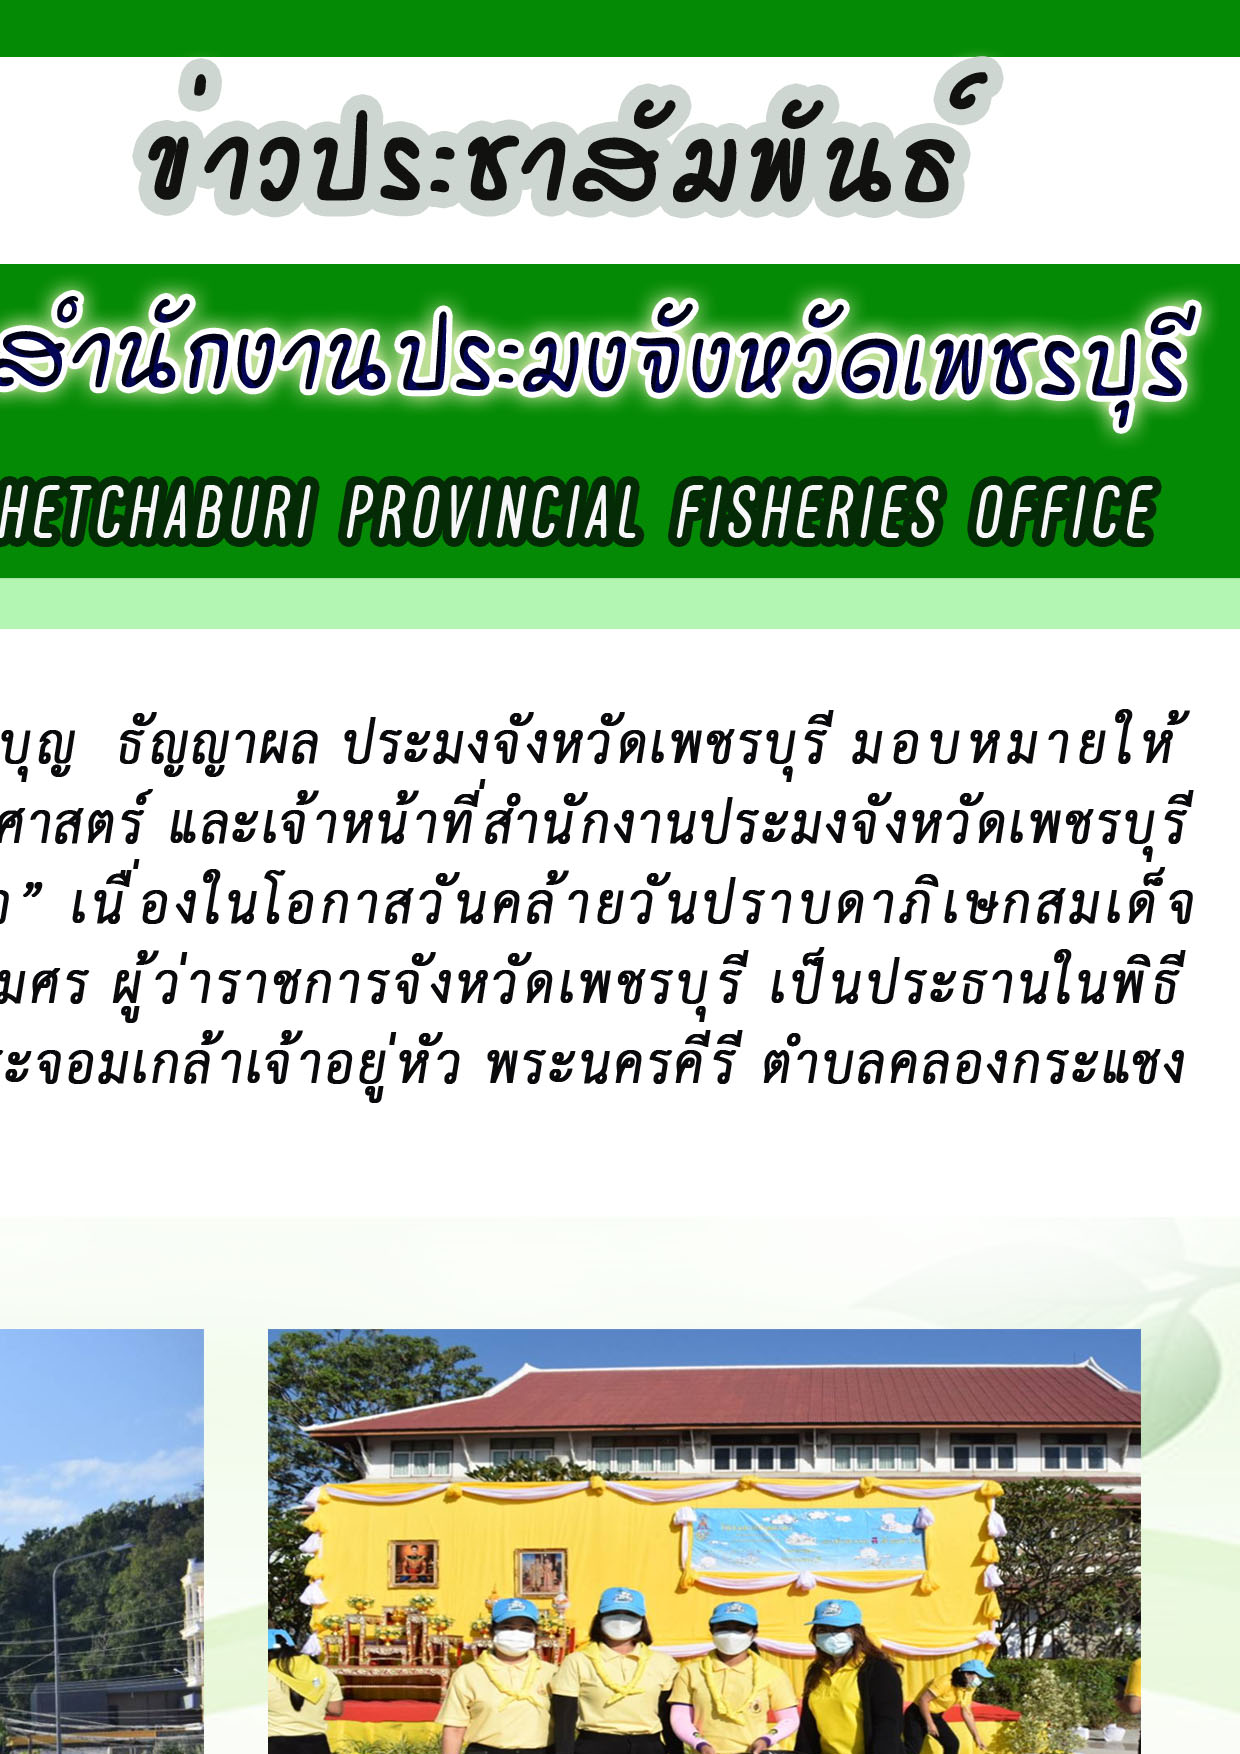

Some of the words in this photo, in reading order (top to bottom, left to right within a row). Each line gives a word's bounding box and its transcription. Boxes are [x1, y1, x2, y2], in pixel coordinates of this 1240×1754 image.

[148, 72, 987, 202] ข่าวประชาสัมพันธ์
[346, 484, 636, 539] PROVINCIAL
[676, 484, 939, 539] FISHERIES
[975, 484, 1154, 539] OFFICE
[120, 712, 317, 777] ธัญญาผล
[345, 710, 833, 782] ประมงจังหวัดเพชรบุรี
[852, 709, 1190, 764] มอบหมายให้
[113, 950, 748, 1023] ผู้ว่าราชการจังหวัดเพชรบุรี
[772, 947, 1185, 1004] เป็นประธานในพิธี
[488, 1030, 742, 1084] พระนครคีรี
[764, 1033, 1184, 1084] ตำบลคลองกระแชง
